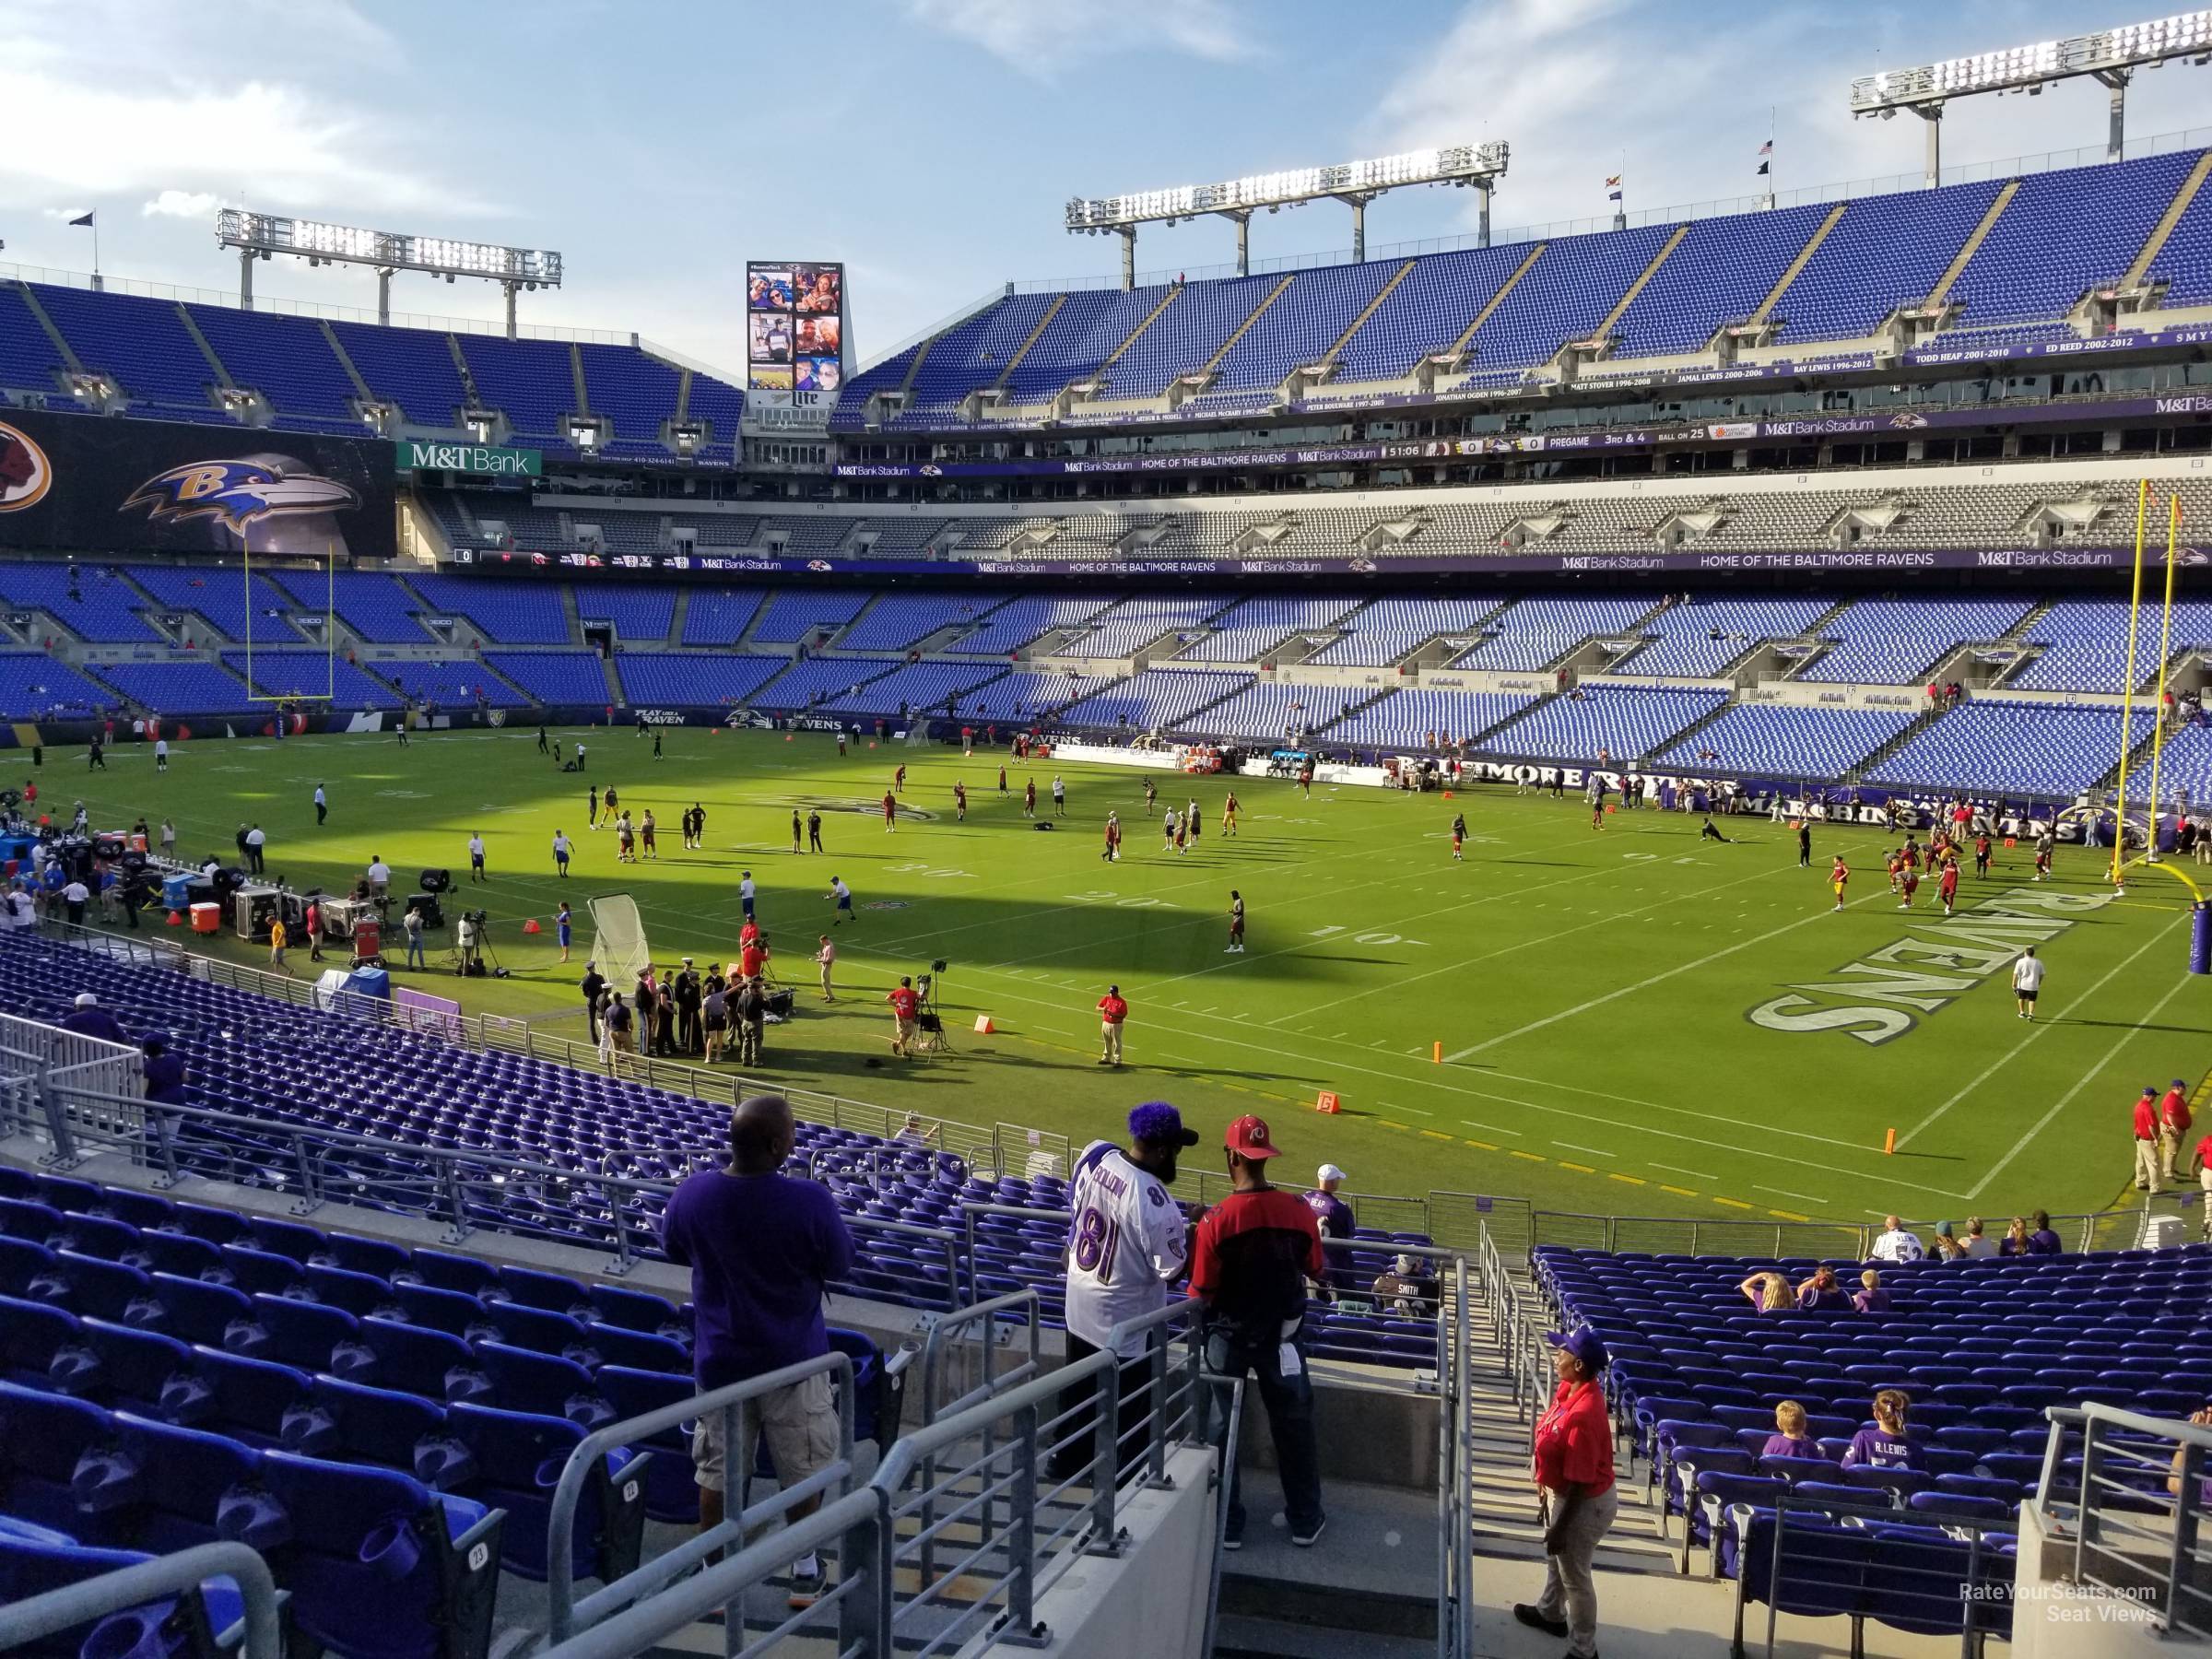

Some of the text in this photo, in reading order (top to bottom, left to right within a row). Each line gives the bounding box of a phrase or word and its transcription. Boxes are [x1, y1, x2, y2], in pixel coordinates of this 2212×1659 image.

[2046, 338, 2133, 353] ED REED 2002-2012
[1916, 348, 2009, 363] TODD HEAP 2001-2010
[1809, 363, 1831, 372] LEWIS
[1832, 359, 1871, 370] 1996-2012
[1677, 369, 1763, 383] JAMAL LEWIS 2000-2006
[1571, 378, 1651, 391] MATT STOVER 1996-2008
[793, 392, 818, 408] Lite
[1435, 388, 1523, 402] JONATHAN OGDEN 1996-2007
[1324, 402, 1354, 411] BOULWARE
[2156, 396, 2212, 413] M&T Ba
[1765, 419, 1874, 435] M&T Bank Stadium
[1389, 446, 1419, 456] 51:06
[1468, 442, 1476, 453] 0
[1530, 440, 1538, 449] 0
[1550, 436, 1589, 447] PREGAME
[1605, 434, 1623, 445] 3RD
[1625, 434, 1635, 443] &
[1637, 433, 1645, 442] 4
[1659, 432, 1676, 441] BALL
[1691, 429, 1704, 438] 25
[411, 444, 528, 473] M&T Bank
[1142, 453, 1286, 469] HOME OF THE BALTIMORE RAVENS
[1298, 449, 1376, 462] M&T Bank Stadium
[837, 466, 910, 475] M&T Bank Stadium
[1065, 461, 1132, 473] M&T Bank Stadium
[701, 559, 782, 570] M&T Bank Stadium
[1562, 556, 1664, 568] M&T Bank Stadium
[1701, 553, 1934, 567] HOME OF THE BALTIMORE RAVENS
[1978, 551, 2112, 565] M&T Bank Stadium
[978, 562, 1046, 572] M&T Bank Stadium
[1070, 562, 1215, 572] HOME OF THE BALTIMORE RAVENS
[1241, 561, 1321, 572] M&T Bank Stadium
[643, 716, 686, 724] RAVEN
[1914, 794, 1998, 806] BALTIORE
[1147, 1183, 1170, 1207] 81
[1311, 1198, 1326, 1208] HEAP
[1076, 1206, 1119, 1286] 81
[1398, 1284, 1419, 1296] SMITH
[1875, 1441, 1907, 1456] R.LEWIS
[626, 1484, 635, 1497] 22
[473, 1549, 484, 1565] 23
